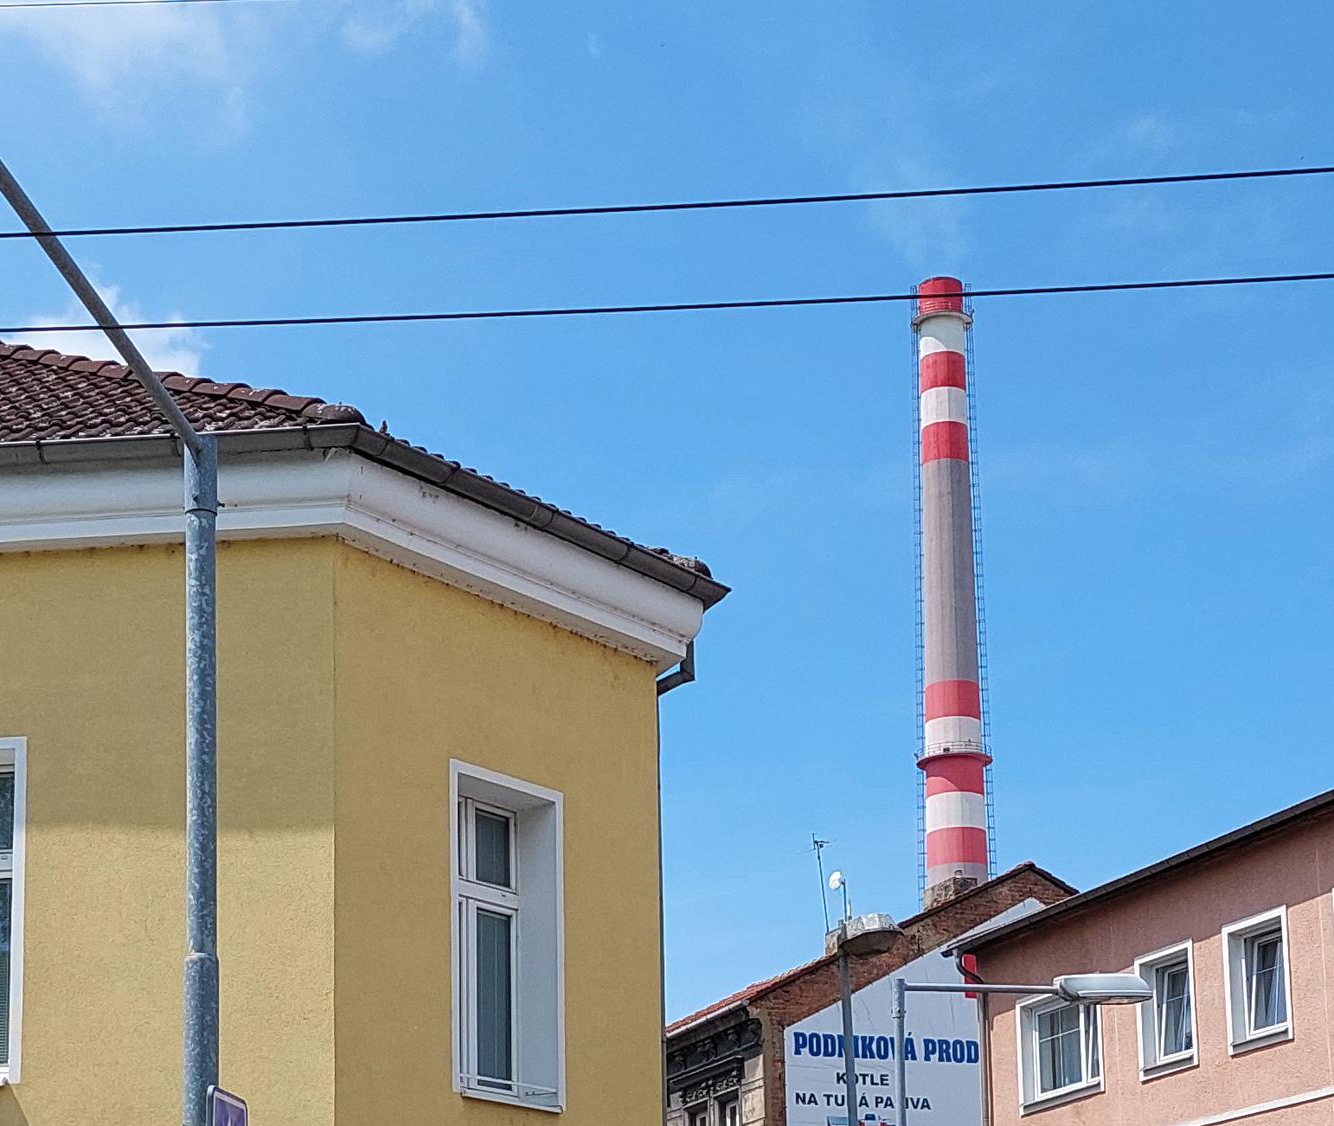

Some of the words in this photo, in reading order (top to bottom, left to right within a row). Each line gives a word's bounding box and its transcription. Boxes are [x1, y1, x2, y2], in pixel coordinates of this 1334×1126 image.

[923, 1038, 979, 1063] PROD
[795, 1092, 819, 1106] NA
[823, 1092, 869, 1108] TUÁ
[874, 1096, 931, 1110] PAIVA
